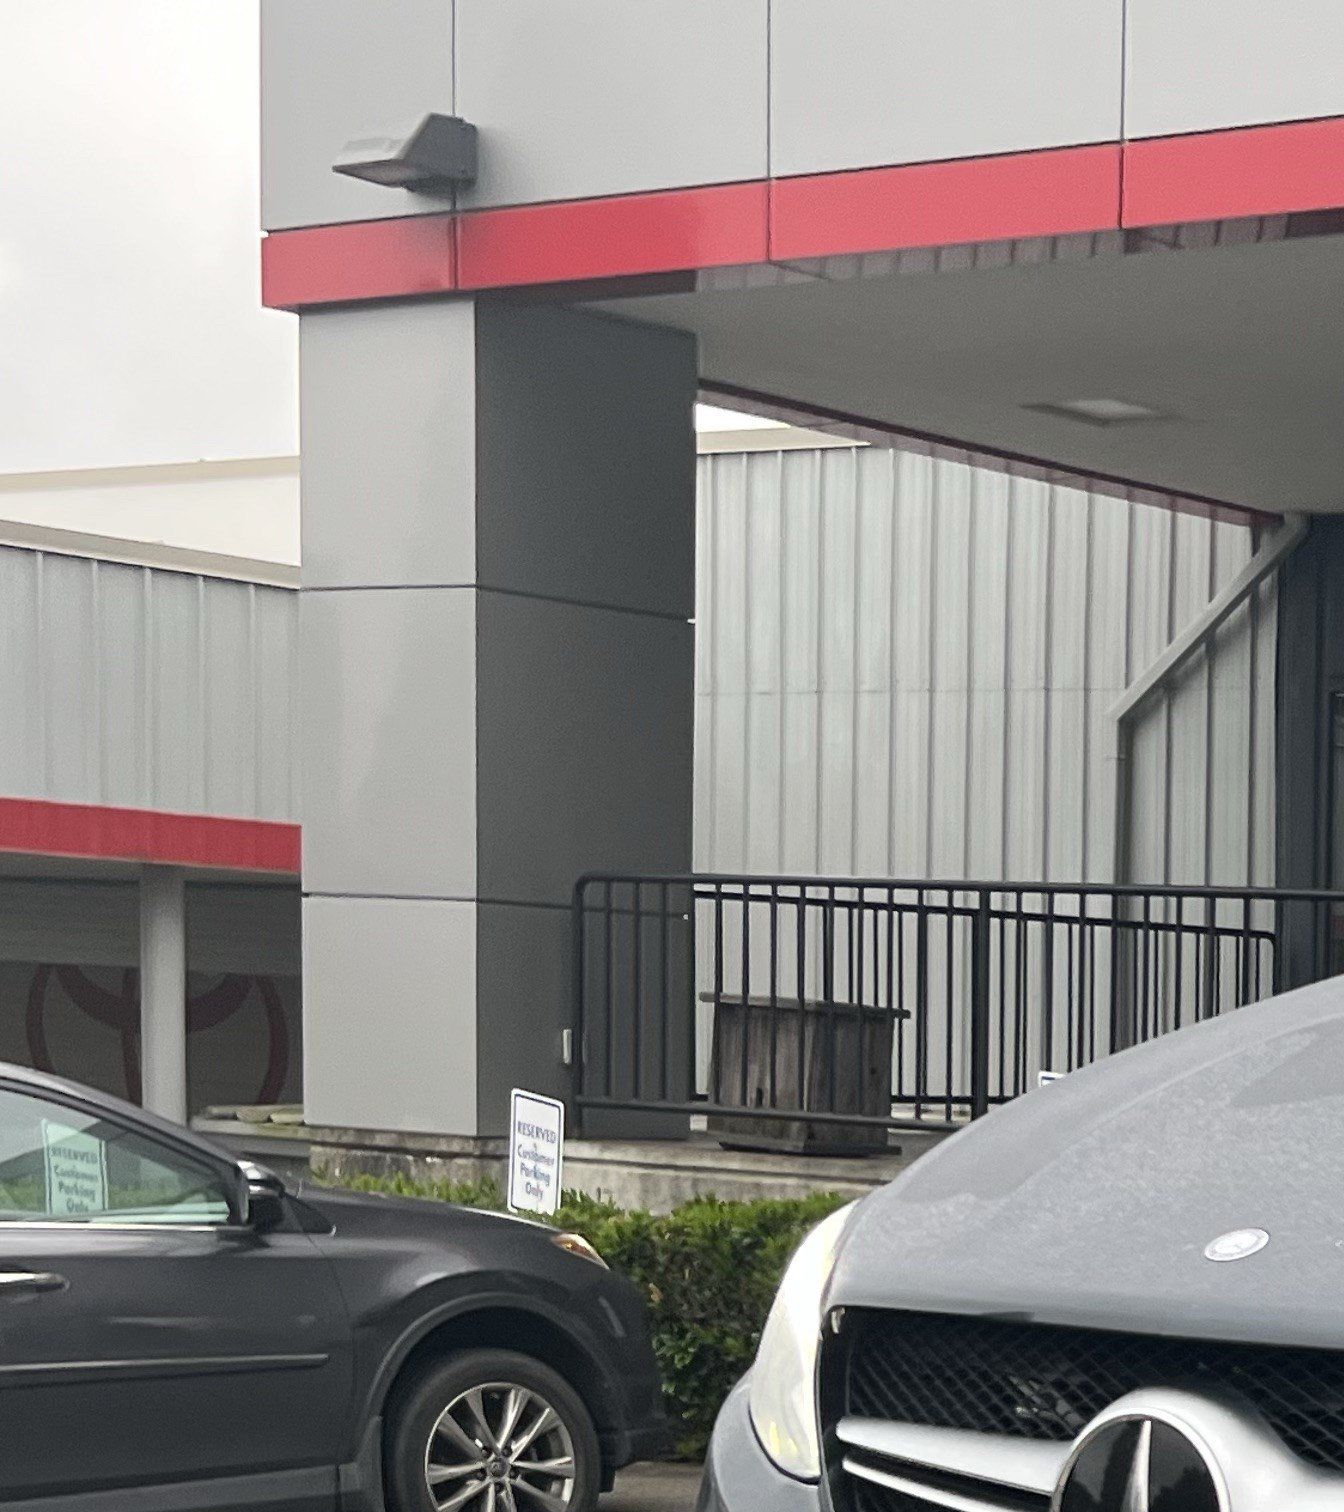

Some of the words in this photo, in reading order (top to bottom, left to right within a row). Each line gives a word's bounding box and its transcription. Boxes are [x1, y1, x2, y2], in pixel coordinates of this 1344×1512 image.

[517, 1120, 556, 1144] RESERVED
[517, 1143, 555, 1166] Customer
[520, 1162, 551, 1188] Parking
[525, 1181, 544, 1200] Only
